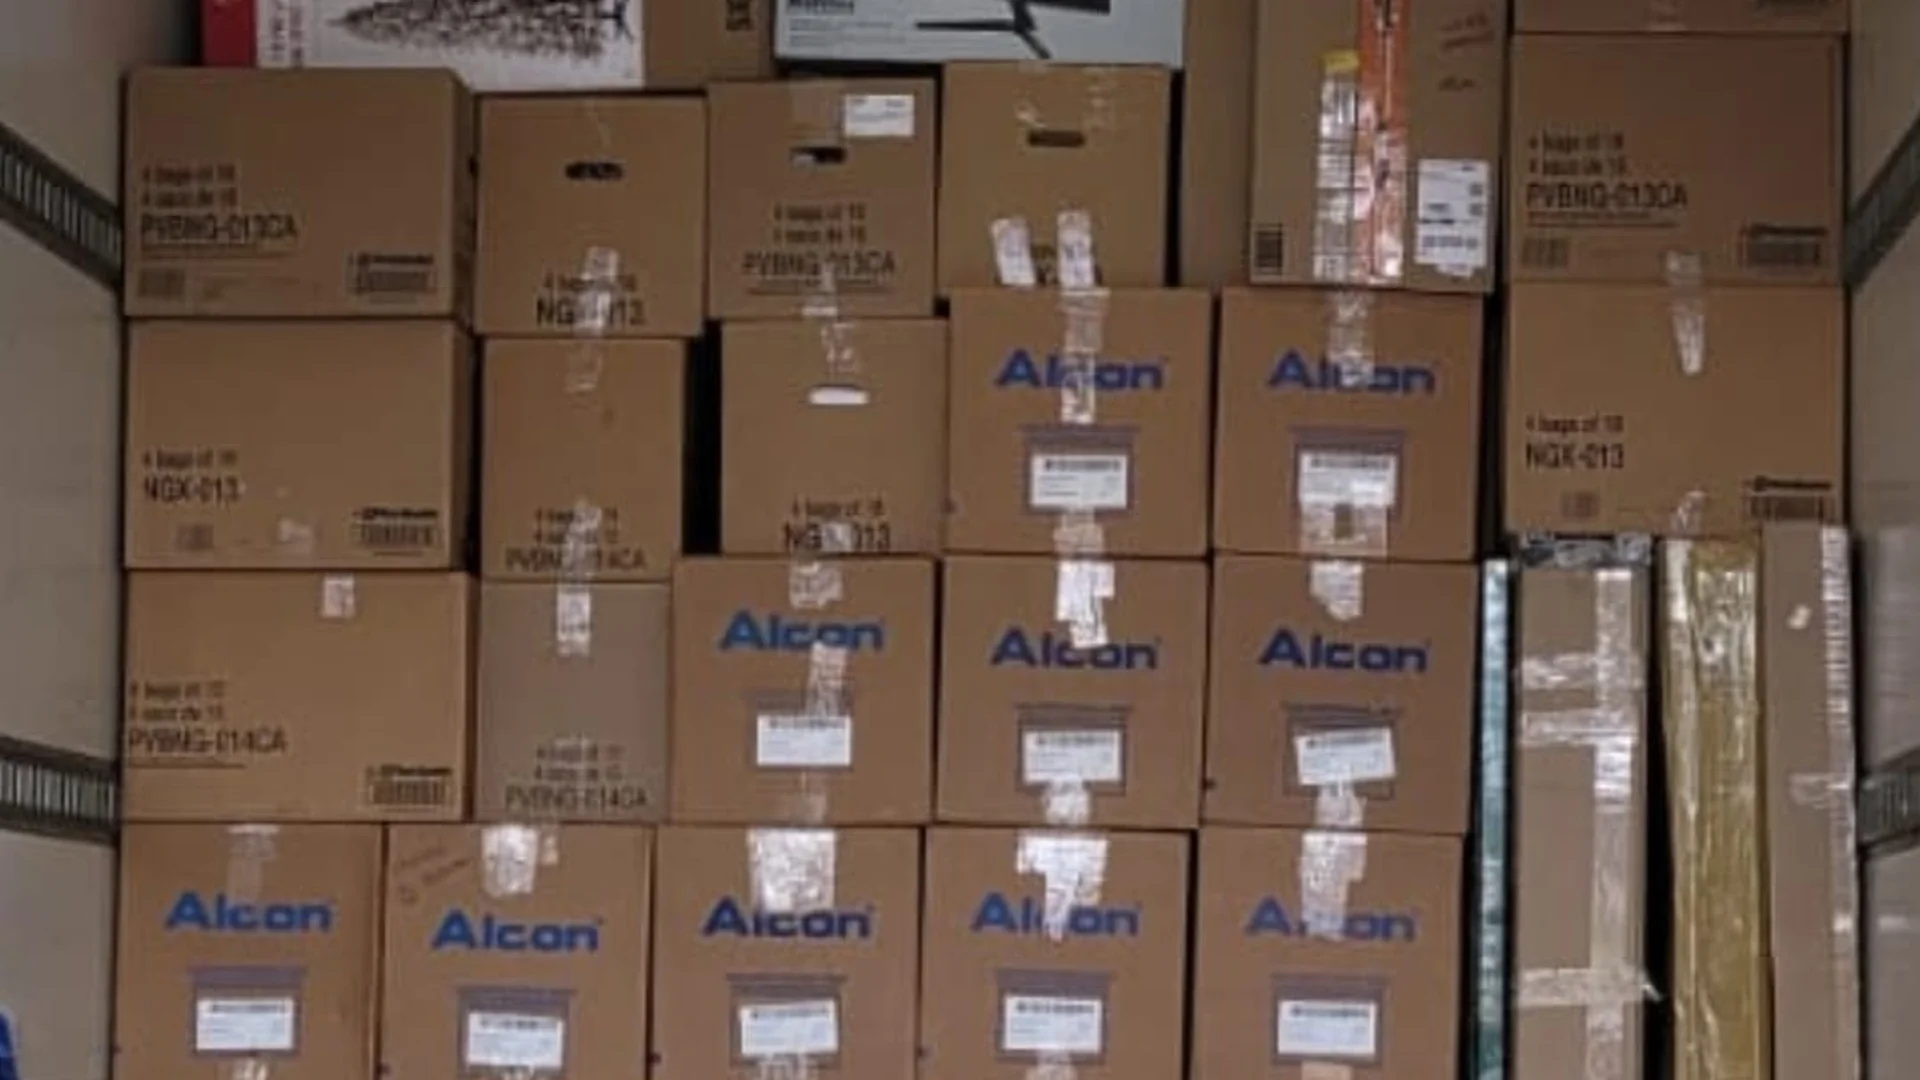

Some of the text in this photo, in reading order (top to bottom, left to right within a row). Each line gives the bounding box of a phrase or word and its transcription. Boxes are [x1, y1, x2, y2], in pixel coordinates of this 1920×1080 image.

[717, 608, 884, 651] Alcon
[1258, 627, 1427, 674] Alcon
[163, 890, 331, 932] Alcon
[430, 907, 598, 952] Alcon
